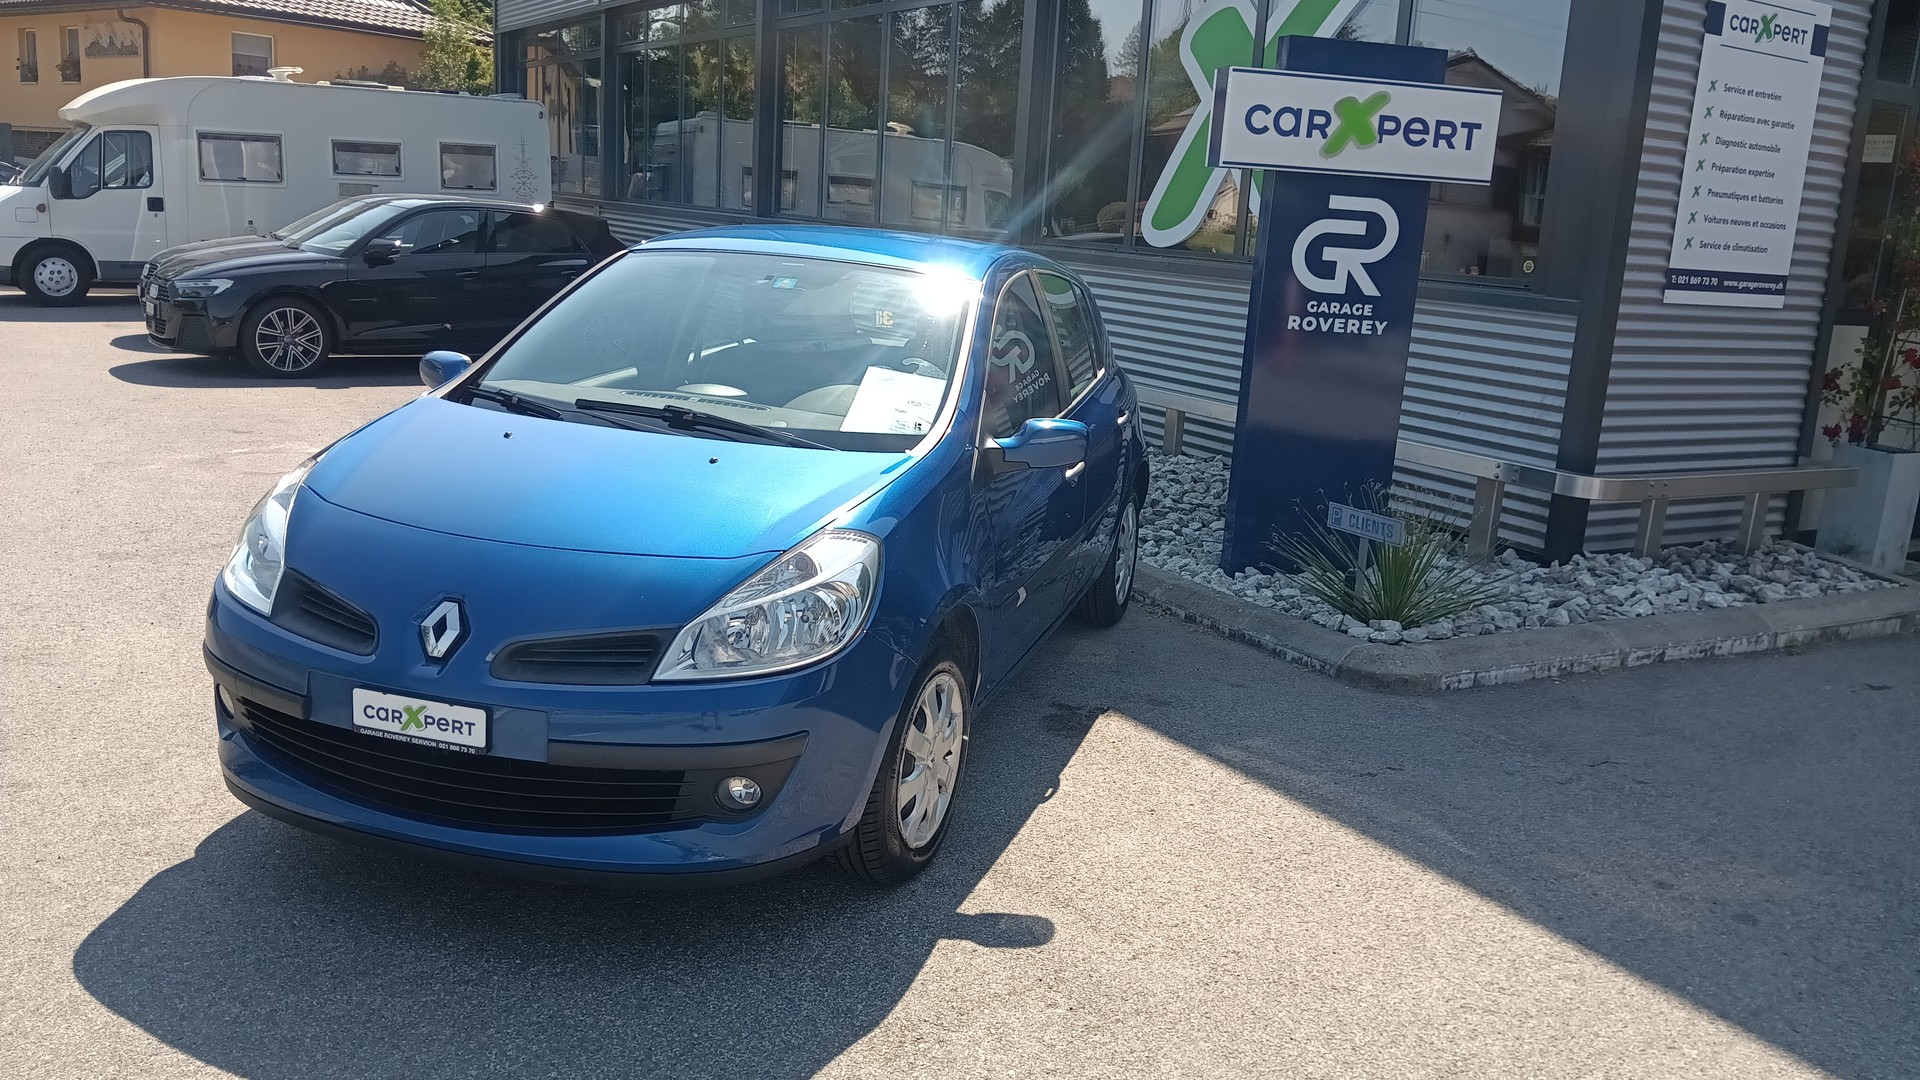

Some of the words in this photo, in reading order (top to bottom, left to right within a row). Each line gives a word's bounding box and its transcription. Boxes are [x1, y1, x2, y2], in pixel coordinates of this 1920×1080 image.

[1723, 83, 1746, 96] Service
[1747, 89, 1754, 97] et
[1755, 91, 1782, 101] entretien
[1719, 110, 1755, 124] Réparations
[1757, 117, 1770, 126] avec
[1771, 120, 1795, 130] garantie
[1715, 136, 1747, 149] Diagnostic
[1748, 142, 1781, 154] automobile
[1711, 162, 1747, 175] Préparation
[1748, 169, 1775, 179] expertise
[1707, 188, 1749, 202] Pneumatiques
[1751, 194, 1757, 202] et
[1758, 193, 1784, 205] batteries
[1704, 214, 1729, 225] Voitures
[1730, 218, 1751, 227] neuves
[1752, 220, 1759, 228] et
[1760, 221, 1786, 230] occasions
[1699, 240, 1721, 250] Service
[1723, 242, 1730, 251] de
[1732, 242, 1768, 254] climatisation
[1677, 275, 1689, 284] 021
[1690, 276, 1700, 285] 869
[1702, 277, 1709, 285] 73
[1710, 277, 1718, 286] 70
[1306, 300, 1373, 316] GARAGE
[1287, 315, 1388, 336] ROVEREY
[1349, 513, 1394, 539] CLIENTS
[360, 728, 383, 738] GARAGE
[384, 732, 410, 743] ROVEREY
[411, 737, 437, 748] SERVION
[438, 742, 448, 750] 021
